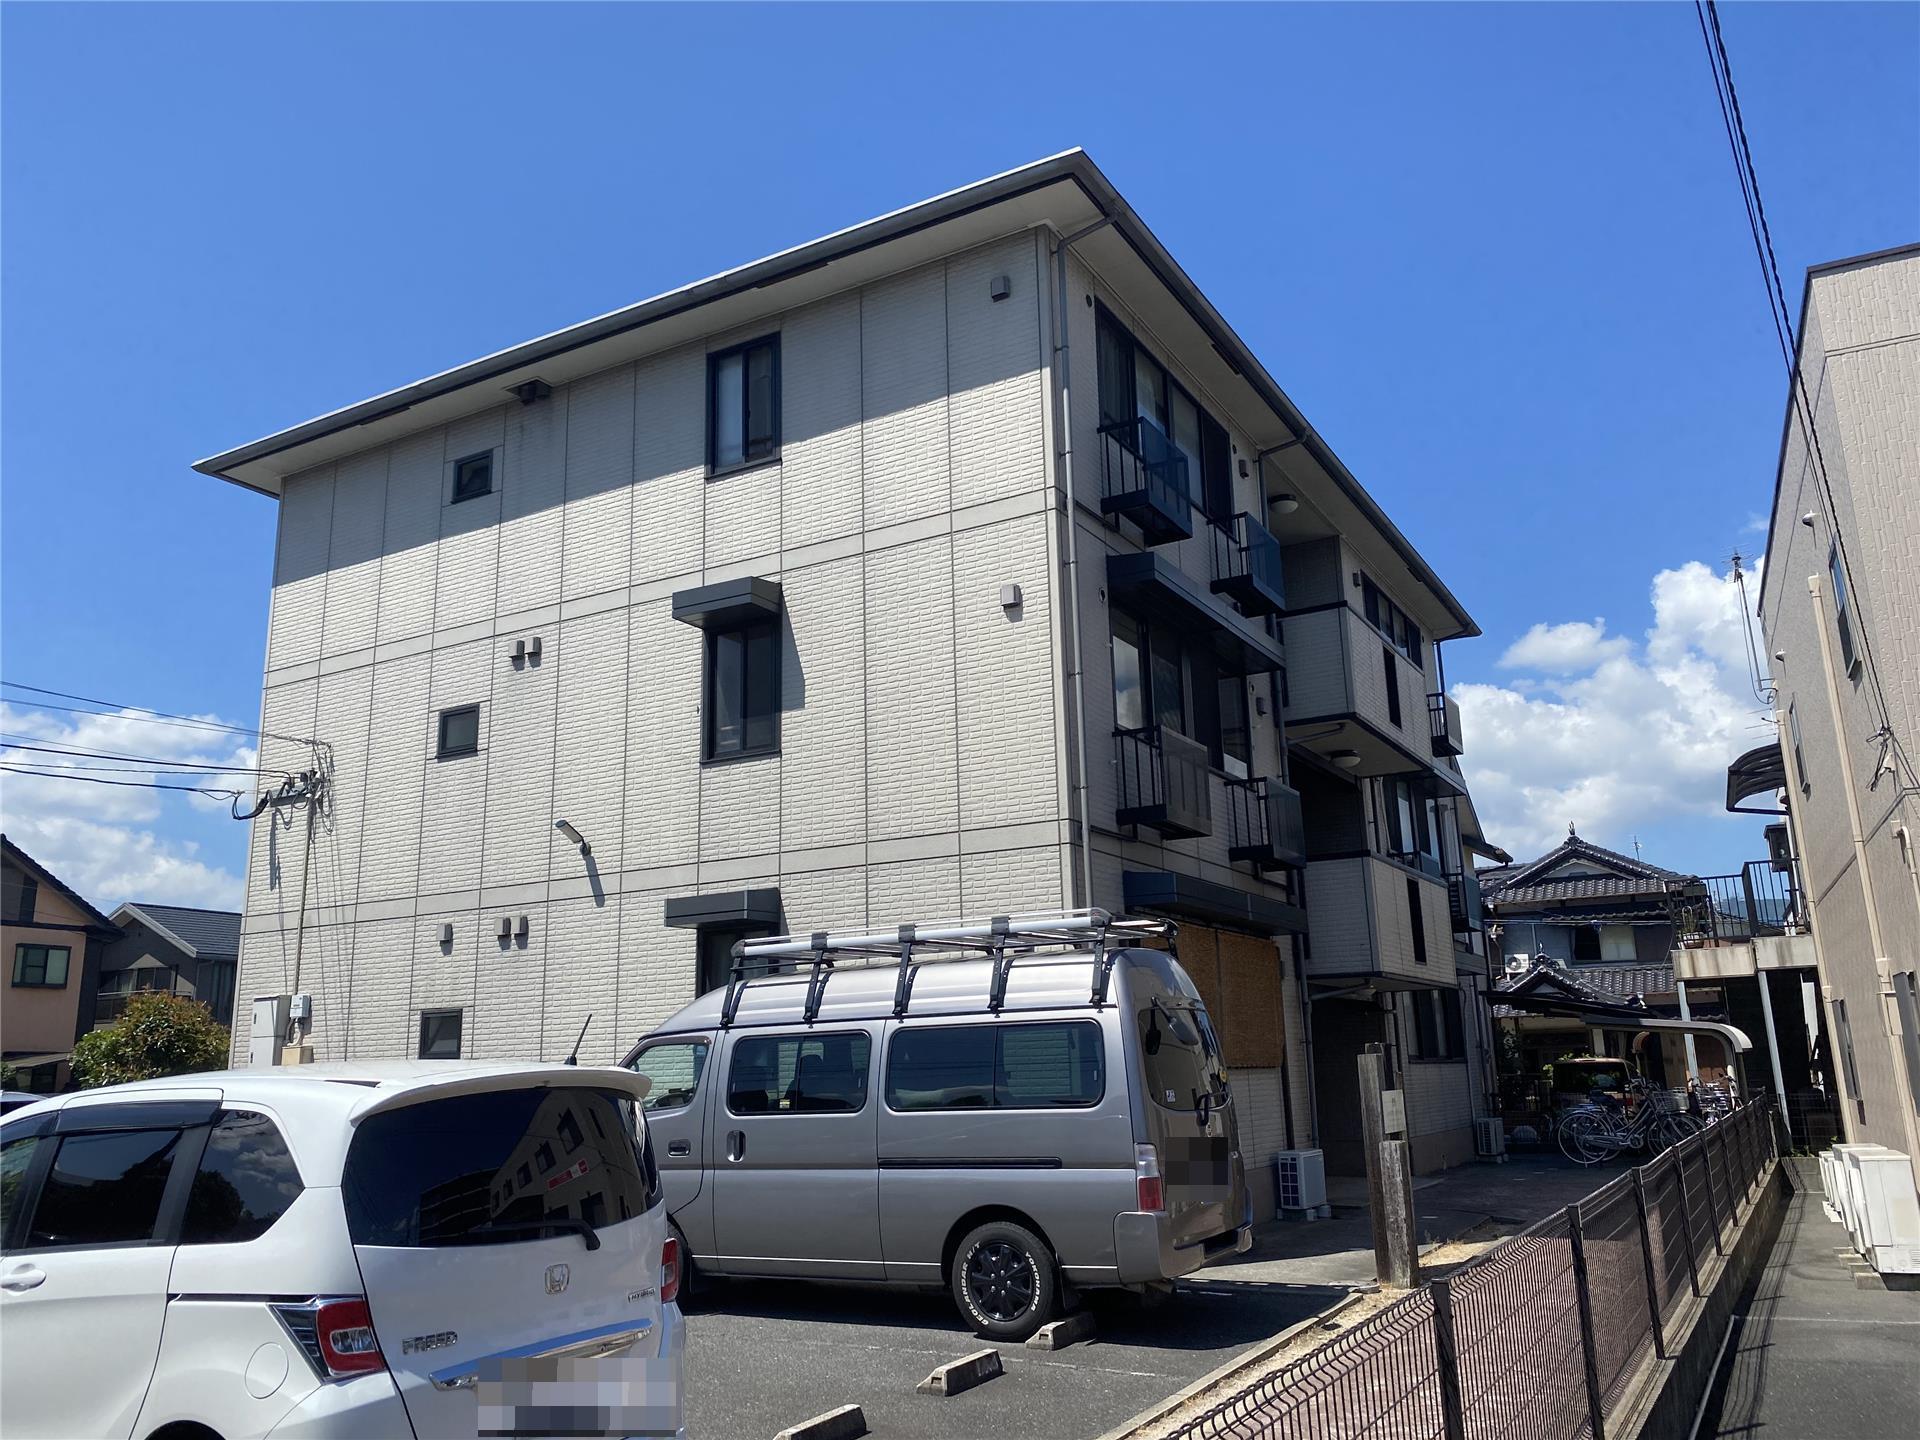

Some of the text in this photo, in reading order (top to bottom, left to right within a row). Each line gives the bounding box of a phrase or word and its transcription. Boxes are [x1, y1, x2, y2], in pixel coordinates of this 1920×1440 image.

[961, 1262, 989, 1325] GEOLANDAR
[1025, 1251, 1040, 1311] YOKOHAMA
[402, 1330, 458, 1355] FREED
